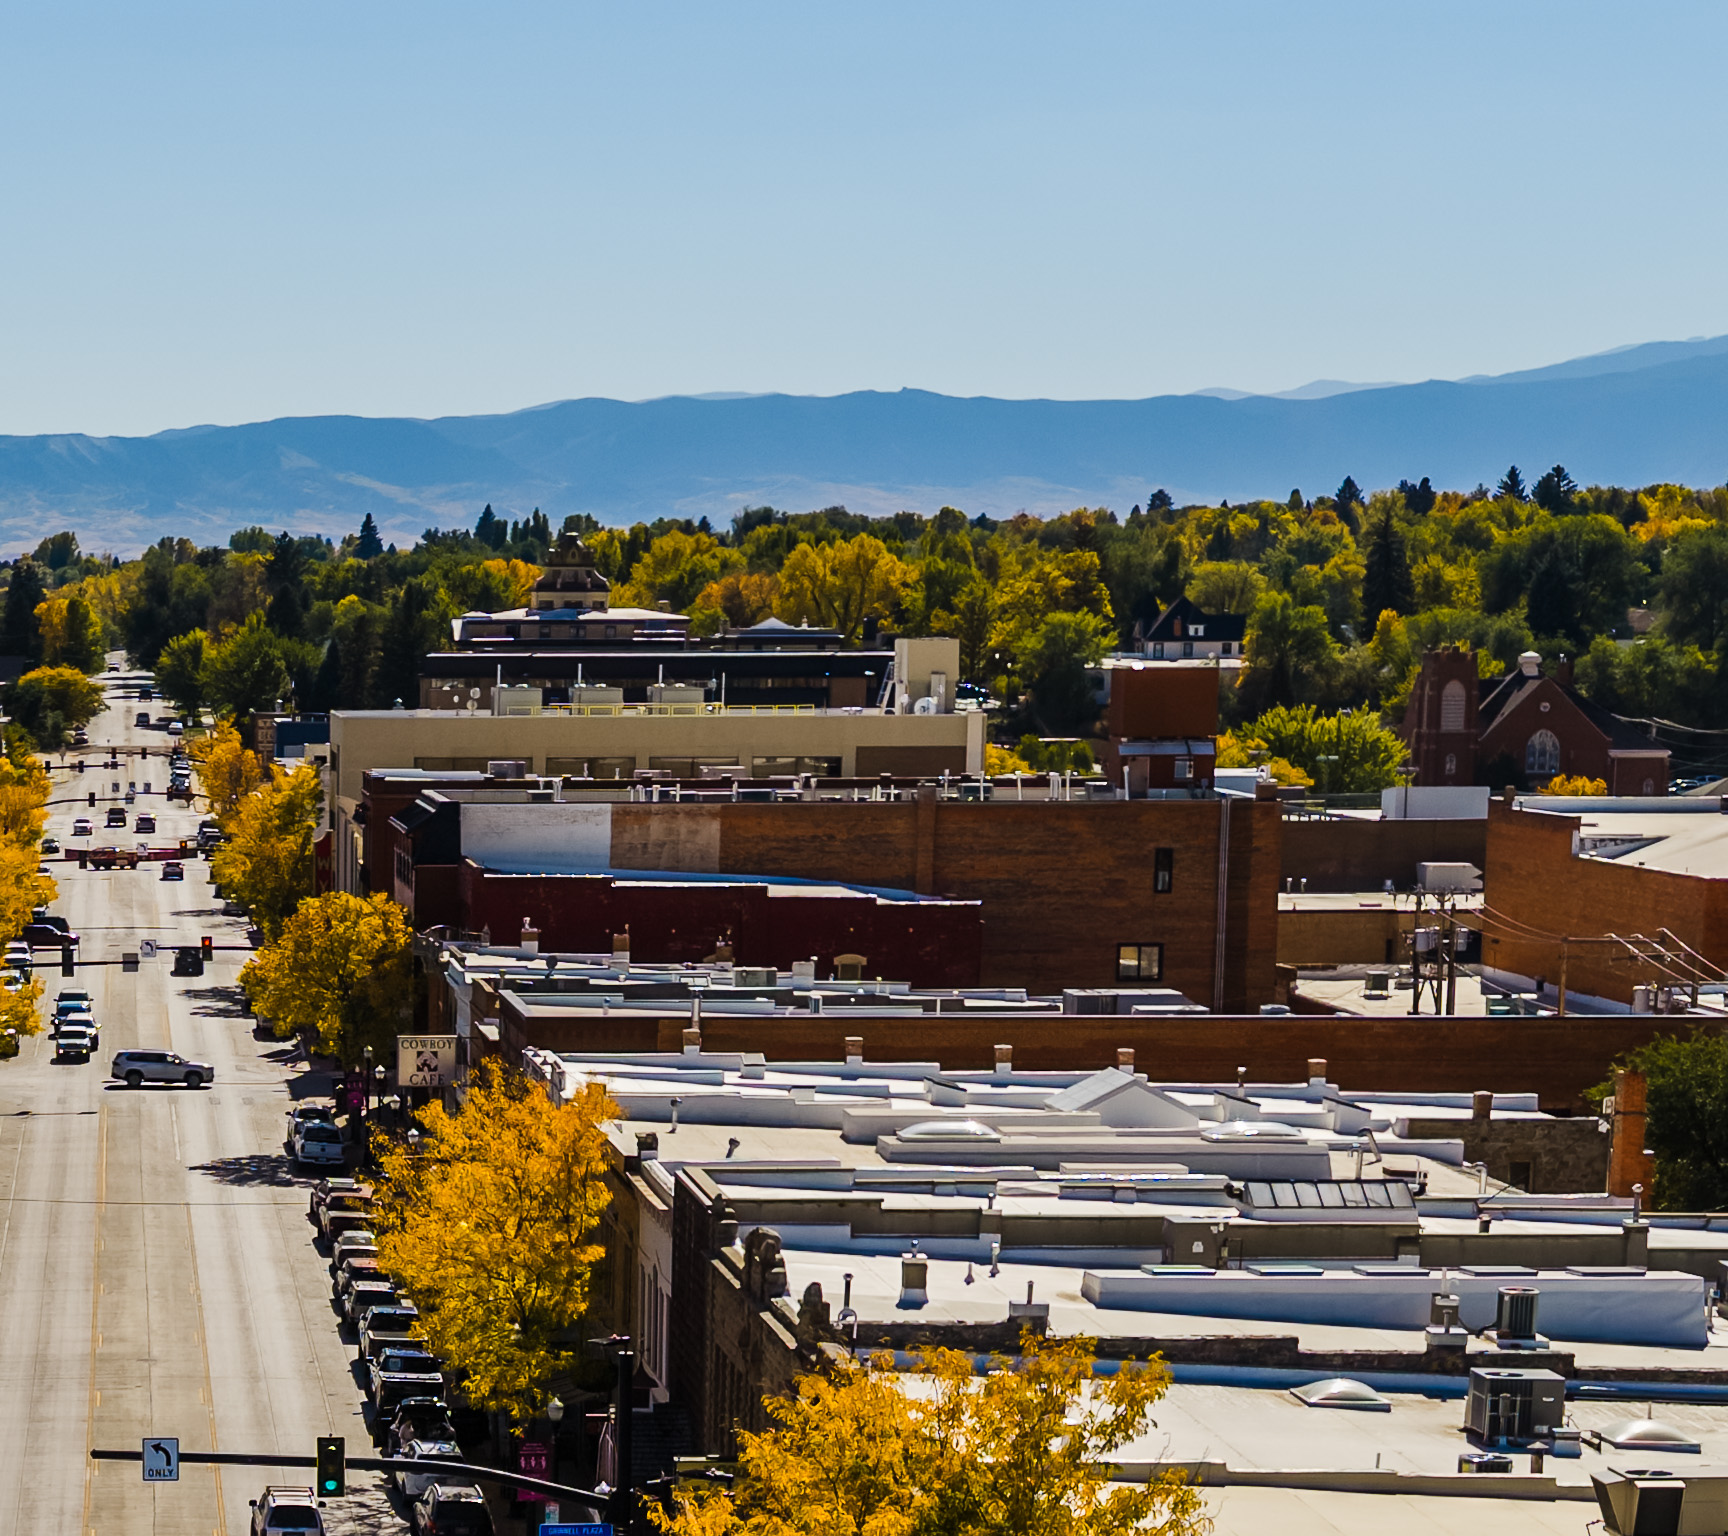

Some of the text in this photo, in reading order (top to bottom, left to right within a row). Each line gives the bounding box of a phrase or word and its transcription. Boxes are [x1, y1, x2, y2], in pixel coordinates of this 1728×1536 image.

[401, 1039, 452, 1050] COWBOY
[409, 1073, 445, 1085] CAFE
[147, 1468, 174, 1478] ONLY
[582, 1527, 604, 1535] PLAZA
